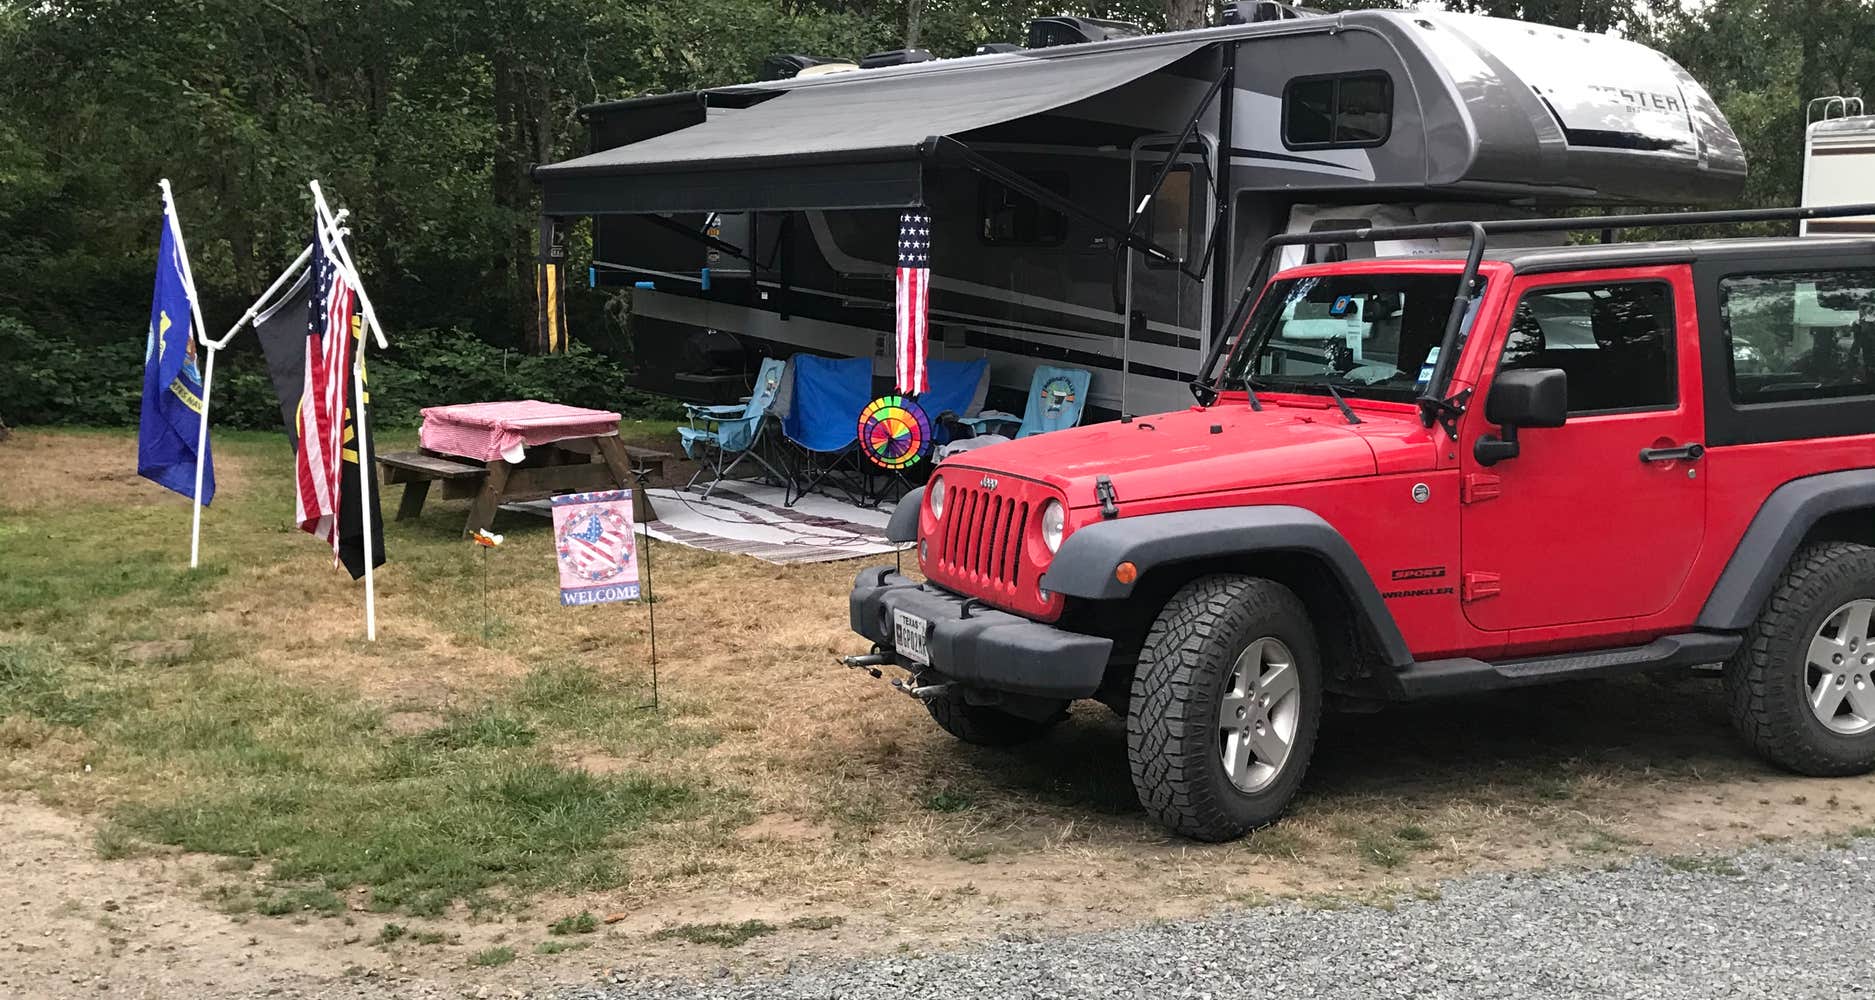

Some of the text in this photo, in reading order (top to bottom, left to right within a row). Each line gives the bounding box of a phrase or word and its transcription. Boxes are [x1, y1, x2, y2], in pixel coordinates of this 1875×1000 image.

[980, 474, 998, 491] Jeep
[1394, 567, 1443, 579] SPORT
[563, 585, 640, 605] WELCOME
[1382, 587, 1454, 599] WRANGLER
[902, 615, 919, 629] TEXAS
